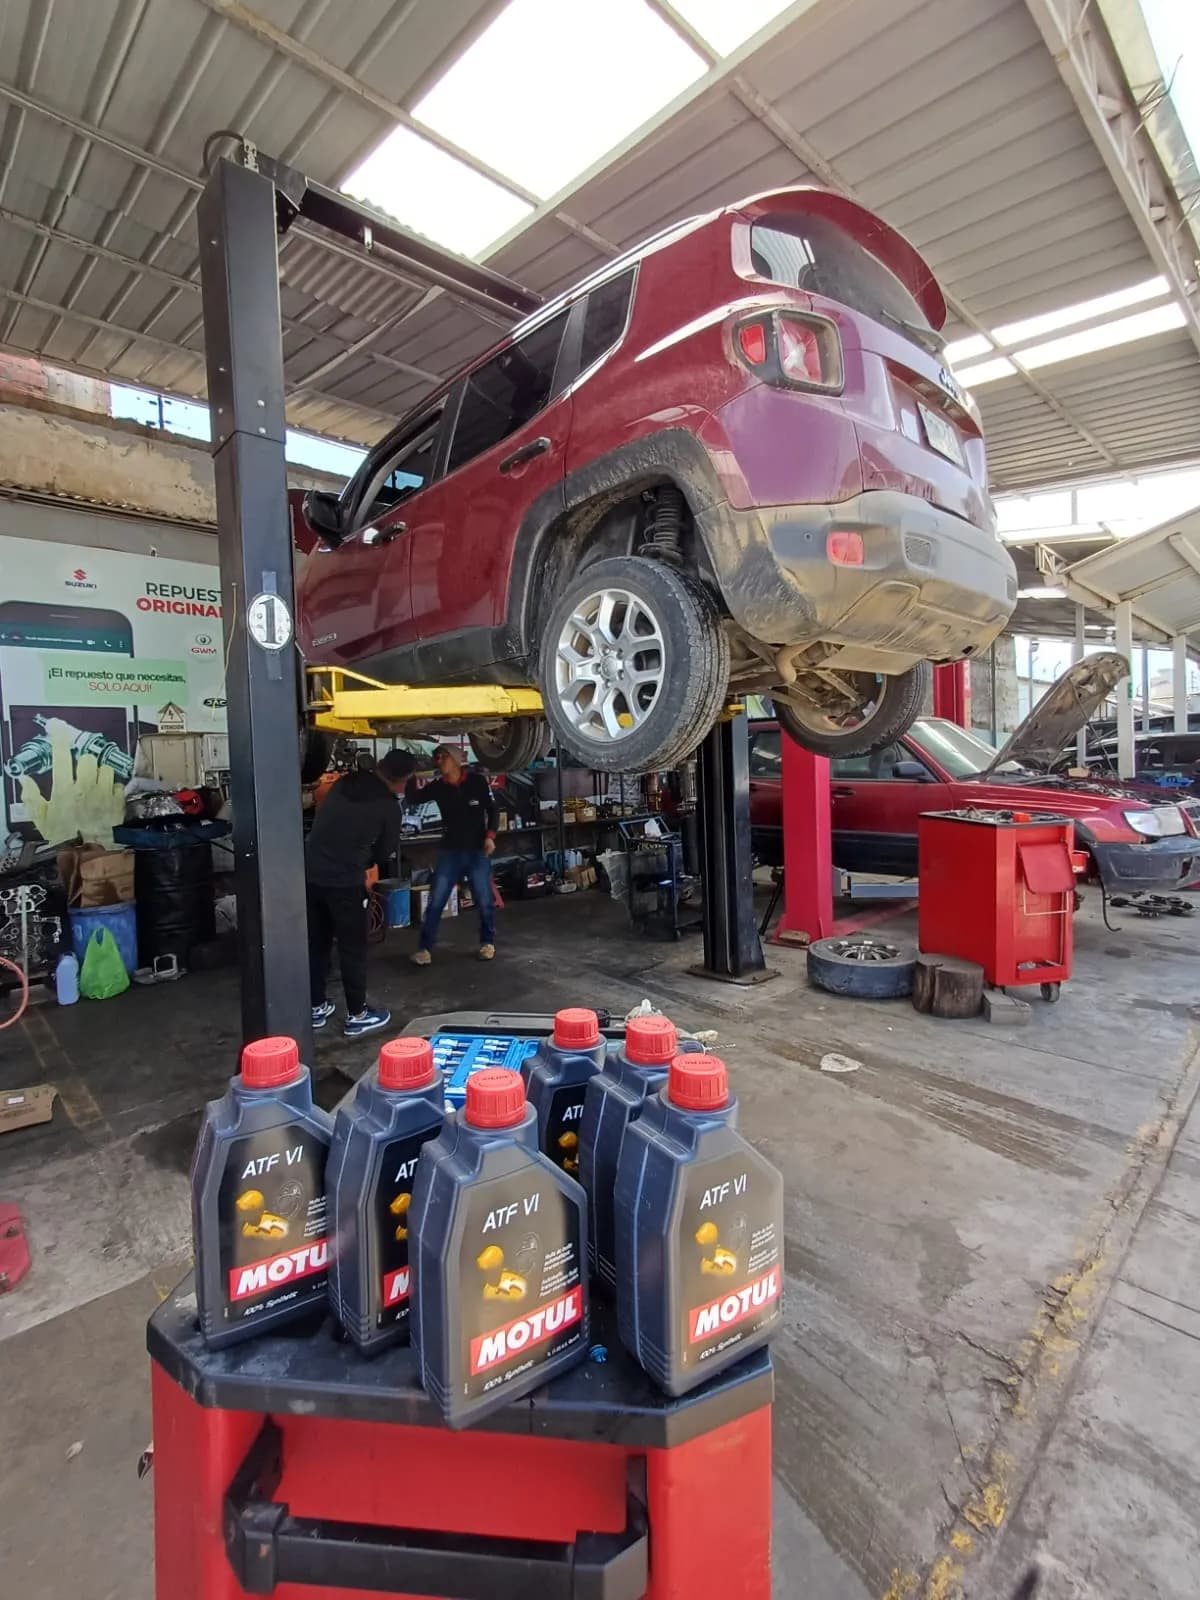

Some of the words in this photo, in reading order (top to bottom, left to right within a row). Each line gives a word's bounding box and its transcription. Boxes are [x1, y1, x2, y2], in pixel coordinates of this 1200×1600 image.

[64, 580, 97, 589] SUZUKI
[65, 670, 114, 681] repuesto
[115, 673, 136, 682] que
[137, 672, 186, 684] necesitas,
[88, 681, 122, 692] SOLO
[241, 1153, 281, 1179] ATF
[285, 1144, 304, 1166] VI
[700, 1182, 730, 1210] ATF
[734, 1173, 748, 1196] VI
[482, 1202, 519, 1233] ATF
[523, 1192, 540, 1216] VI
[695, 1272, 777, 1337] MOTUL
[477, 1295, 577, 1368] MOTUL
